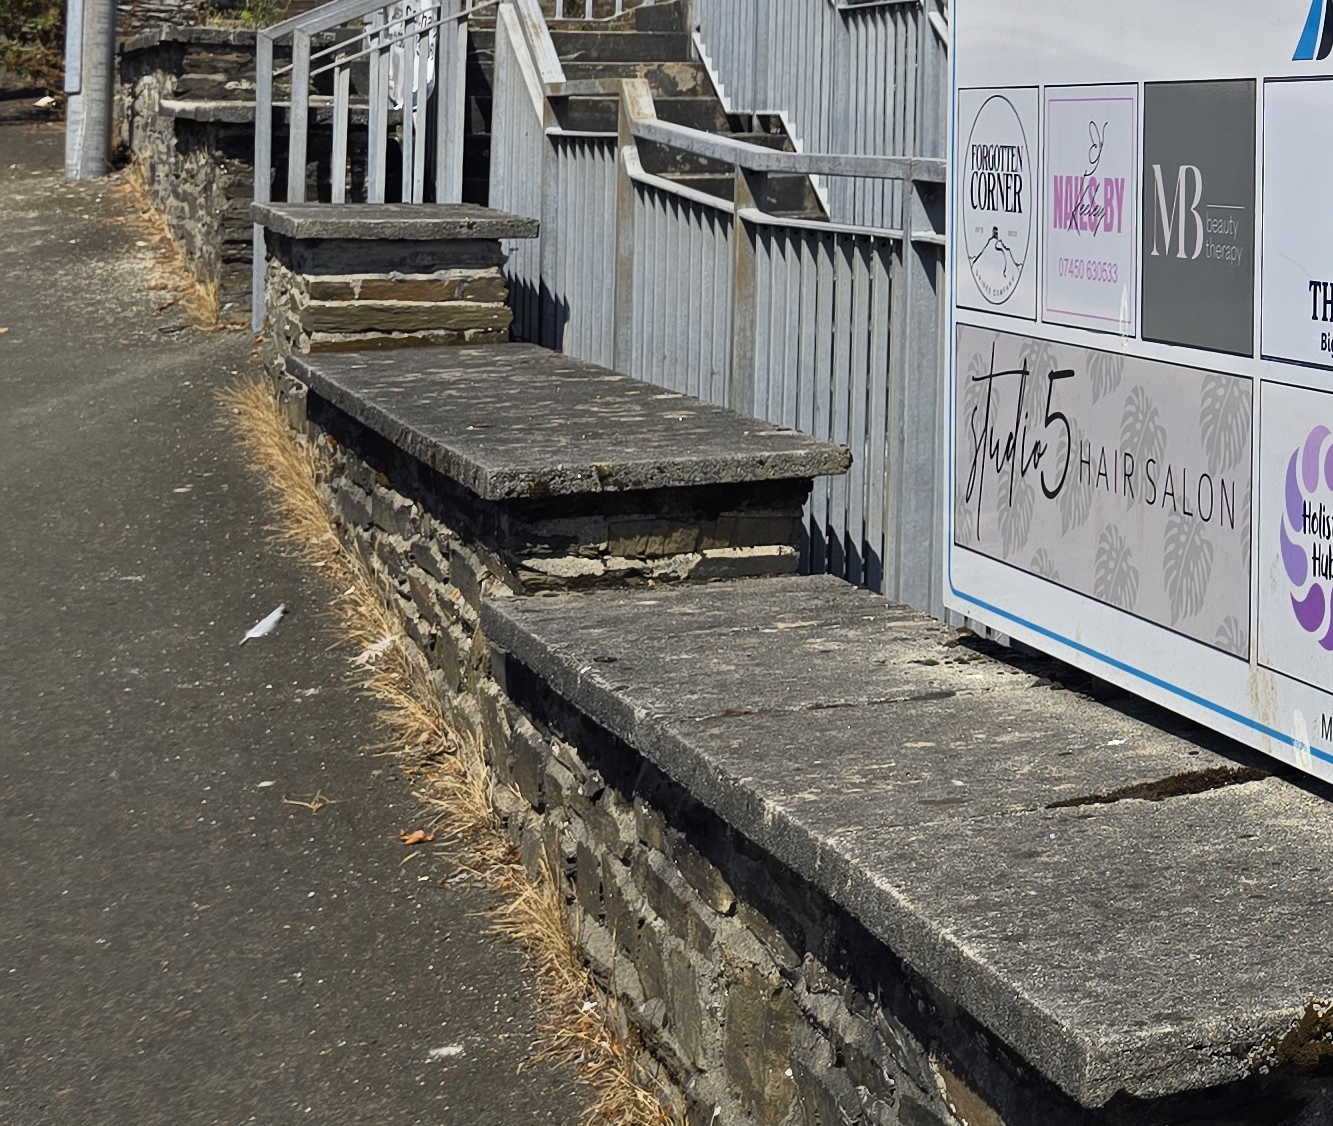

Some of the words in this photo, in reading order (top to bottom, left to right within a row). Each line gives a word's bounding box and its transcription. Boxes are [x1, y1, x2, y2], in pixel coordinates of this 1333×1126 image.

[971, 144, 1023, 173] FORGOTTEN
[970, 171, 1023, 213] CORNER
[1053, 175, 1098, 232] NAILS
[1103, 178, 1125, 234] BY
[1151, 164, 1204, 260] MB
[1206, 211, 1239, 239] beauty
[1206, 237, 1243, 266] therapy
[1058, 257, 1084, 279] 07450
[1086, 258, 1118, 283] 630533
[965, 341, 1048, 541] studio
[1041, 369, 1076, 500] 5
[1079, 440, 1135, 500] HAIR
[1145, 458, 1235, 529] SALON
